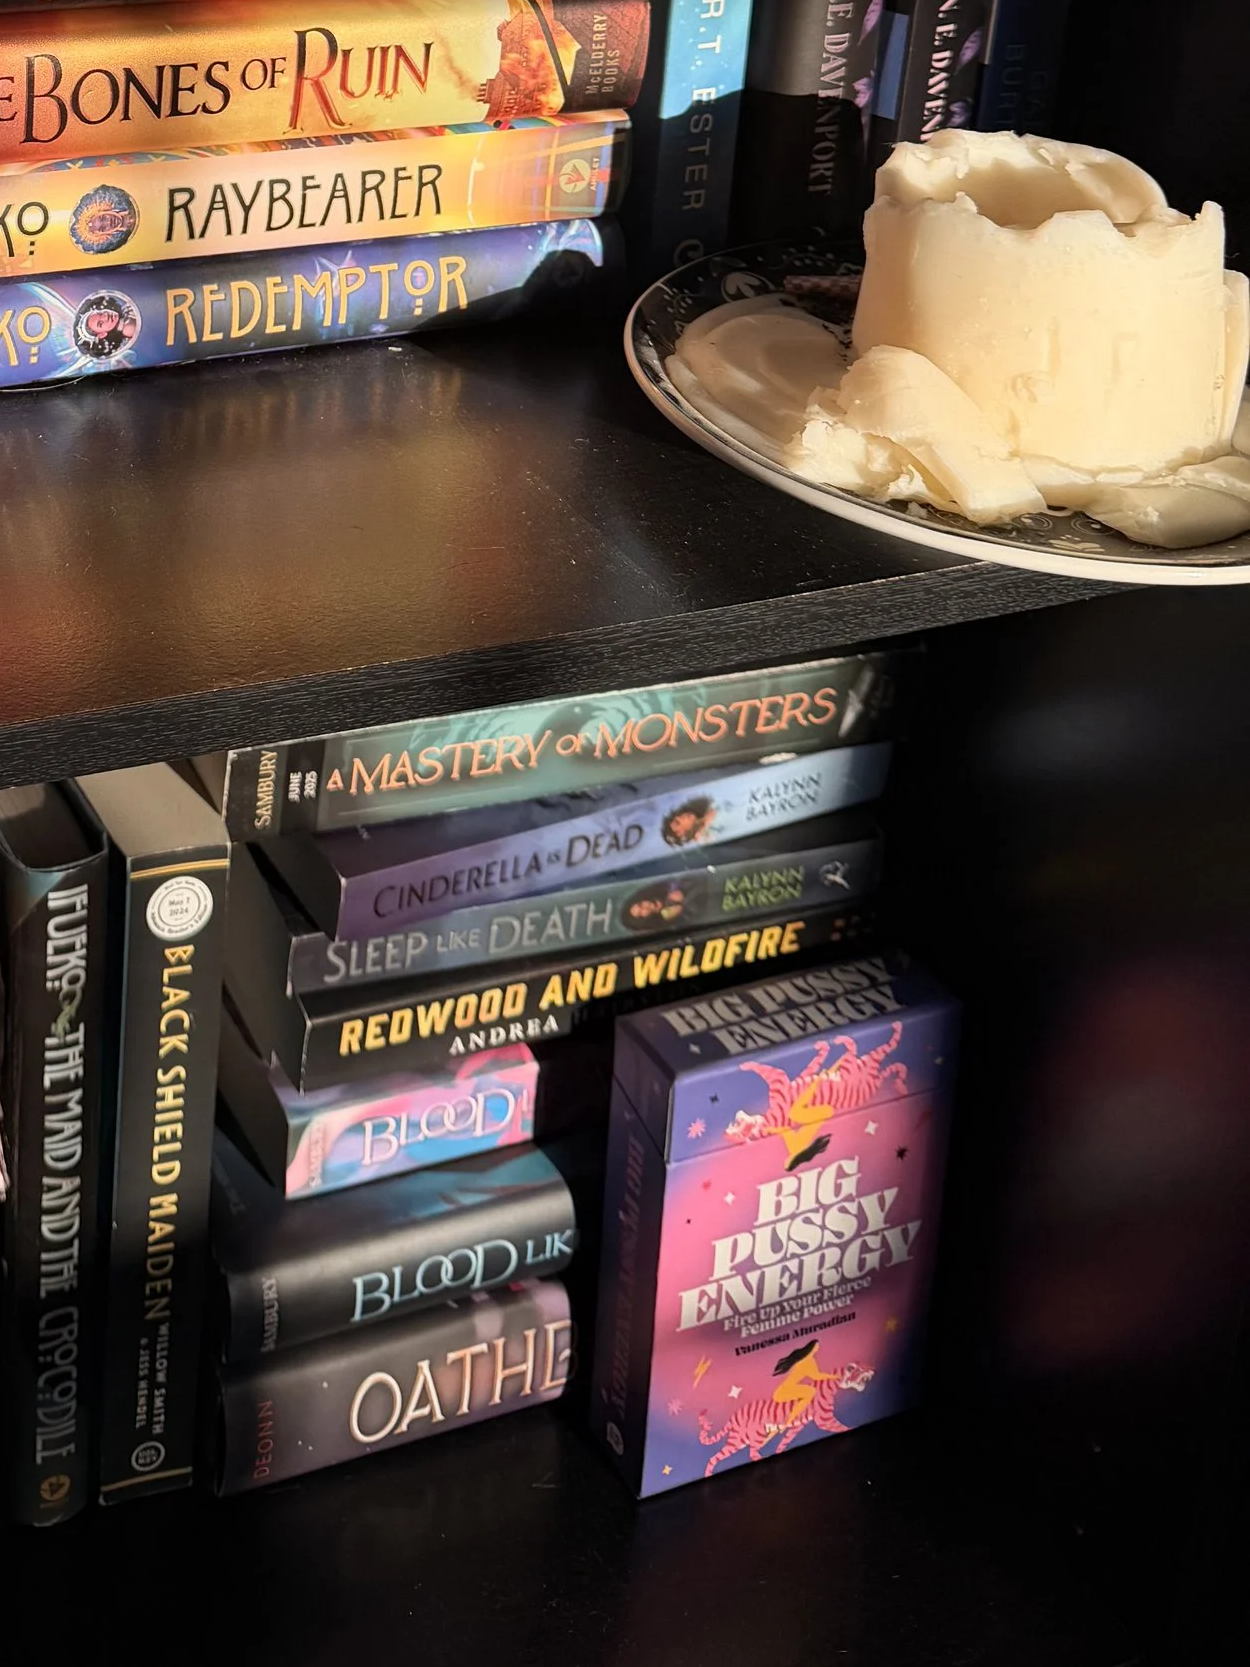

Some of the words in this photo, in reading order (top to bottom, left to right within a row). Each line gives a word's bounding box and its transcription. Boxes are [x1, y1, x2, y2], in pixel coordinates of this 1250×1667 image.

[19, 52, 231, 146] BONES
[282, 26, 435, 136] RUIN
[601, 47, 621, 94] BOOKS
[164, 163, 443, 243] RAYBEARER
[165, 255, 469, 347] REDEMPTOR
[326, 768, 344, 792] A
[349, 729, 553, 796] MASTERY
[592, 686, 839, 760] MONSTERS
[288, 770, 302, 803] JUNE
[372, 853, 543, 919] CINDERELLA
[564, 823, 644, 868] DEAD
[322, 934, 429, 985] SLEEP
[434, 927, 481, 954] LIKE
[487, 898, 613, 956] DEATH
[338, 981, 528, 1056] REDWOOD
[539, 961, 619, 1012] AND
[632, 920, 806, 990] WILDFIRE
[361, 1087, 515, 1166] BLOOD
[753, 1154, 862, 1226] BIG
[143, 1192, 180, 1322] MAIDEN
[676, 1219, 923, 1332] ENERGY
[708, 1186, 899, 1282] PUSSY
[260, 1276, 281, 1353] SAMBURY
[350, 1237, 519, 1324] BLOOD
[782, 1291, 822, 1313] Your
[734, 1333, 791, 1356] Vanessa
[253, 1398, 274, 1481] DEONN
